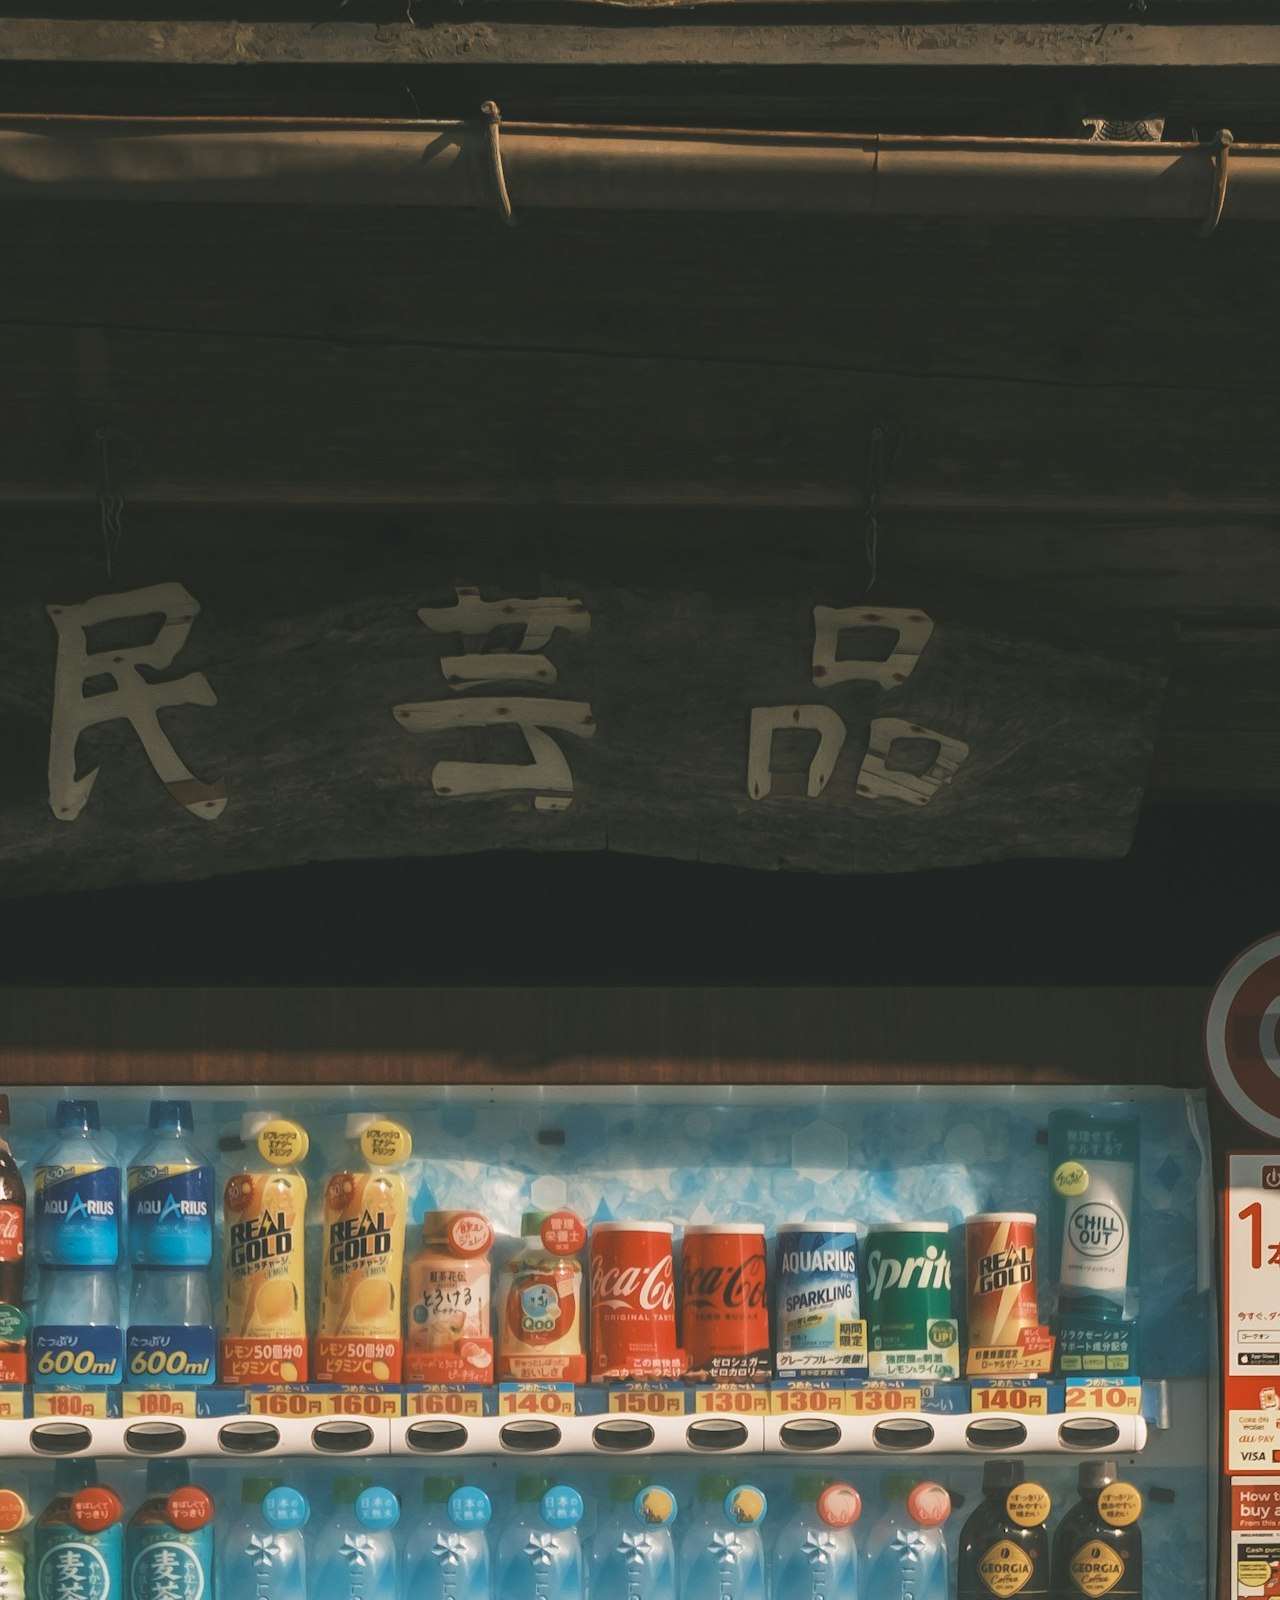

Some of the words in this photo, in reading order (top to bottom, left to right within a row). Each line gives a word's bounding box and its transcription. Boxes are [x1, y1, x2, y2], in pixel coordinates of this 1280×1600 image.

[230, 1209, 291, 1247] REAL
[1074, 1213, 1119, 1232] CHILL
[1079, 1229, 1112, 1246] OUT
[231, 1233, 293, 1268] GOLD
[330, 1232, 393, 1268] GOLD
[783, 1250, 856, 1275] AQUARIUS
[785, 1284, 852, 1313] SPARKLING
[522, 1315, 555, 1333] Qoo
[37, 1335, 78, 1348] たっぷり
[224, 1342, 303, 1358] レモン50個分の
[37, 1351, 118, 1376] 600ml
[130, 1350, 209, 1376] 600ml
[254, 1393, 322, 1414] 160円
[329, 1393, 396, 1414] 160円
[410, 1393, 477, 1414] 160円
[504, 1392, 573, 1414] 140円
[617, 1391, 680, 1414] 150円
[705, 1391, 767, 1414] 130円
[776, 1389, 841, 1412] 130円
[851, 1389, 917, 1412] 130円
[980, 1386, 1041, 1410] 140円
[1065, 1386, 1138, 1409] 210円
[1240, 1451, 1266, 1461] VISA
[1240, 1491, 1270, 1502] How
[1240, 1504, 1271, 1519] buy
[981, 1563, 1030, 1575] GEORGIA
[1072, 1563, 1121, 1575] GEORGIA
